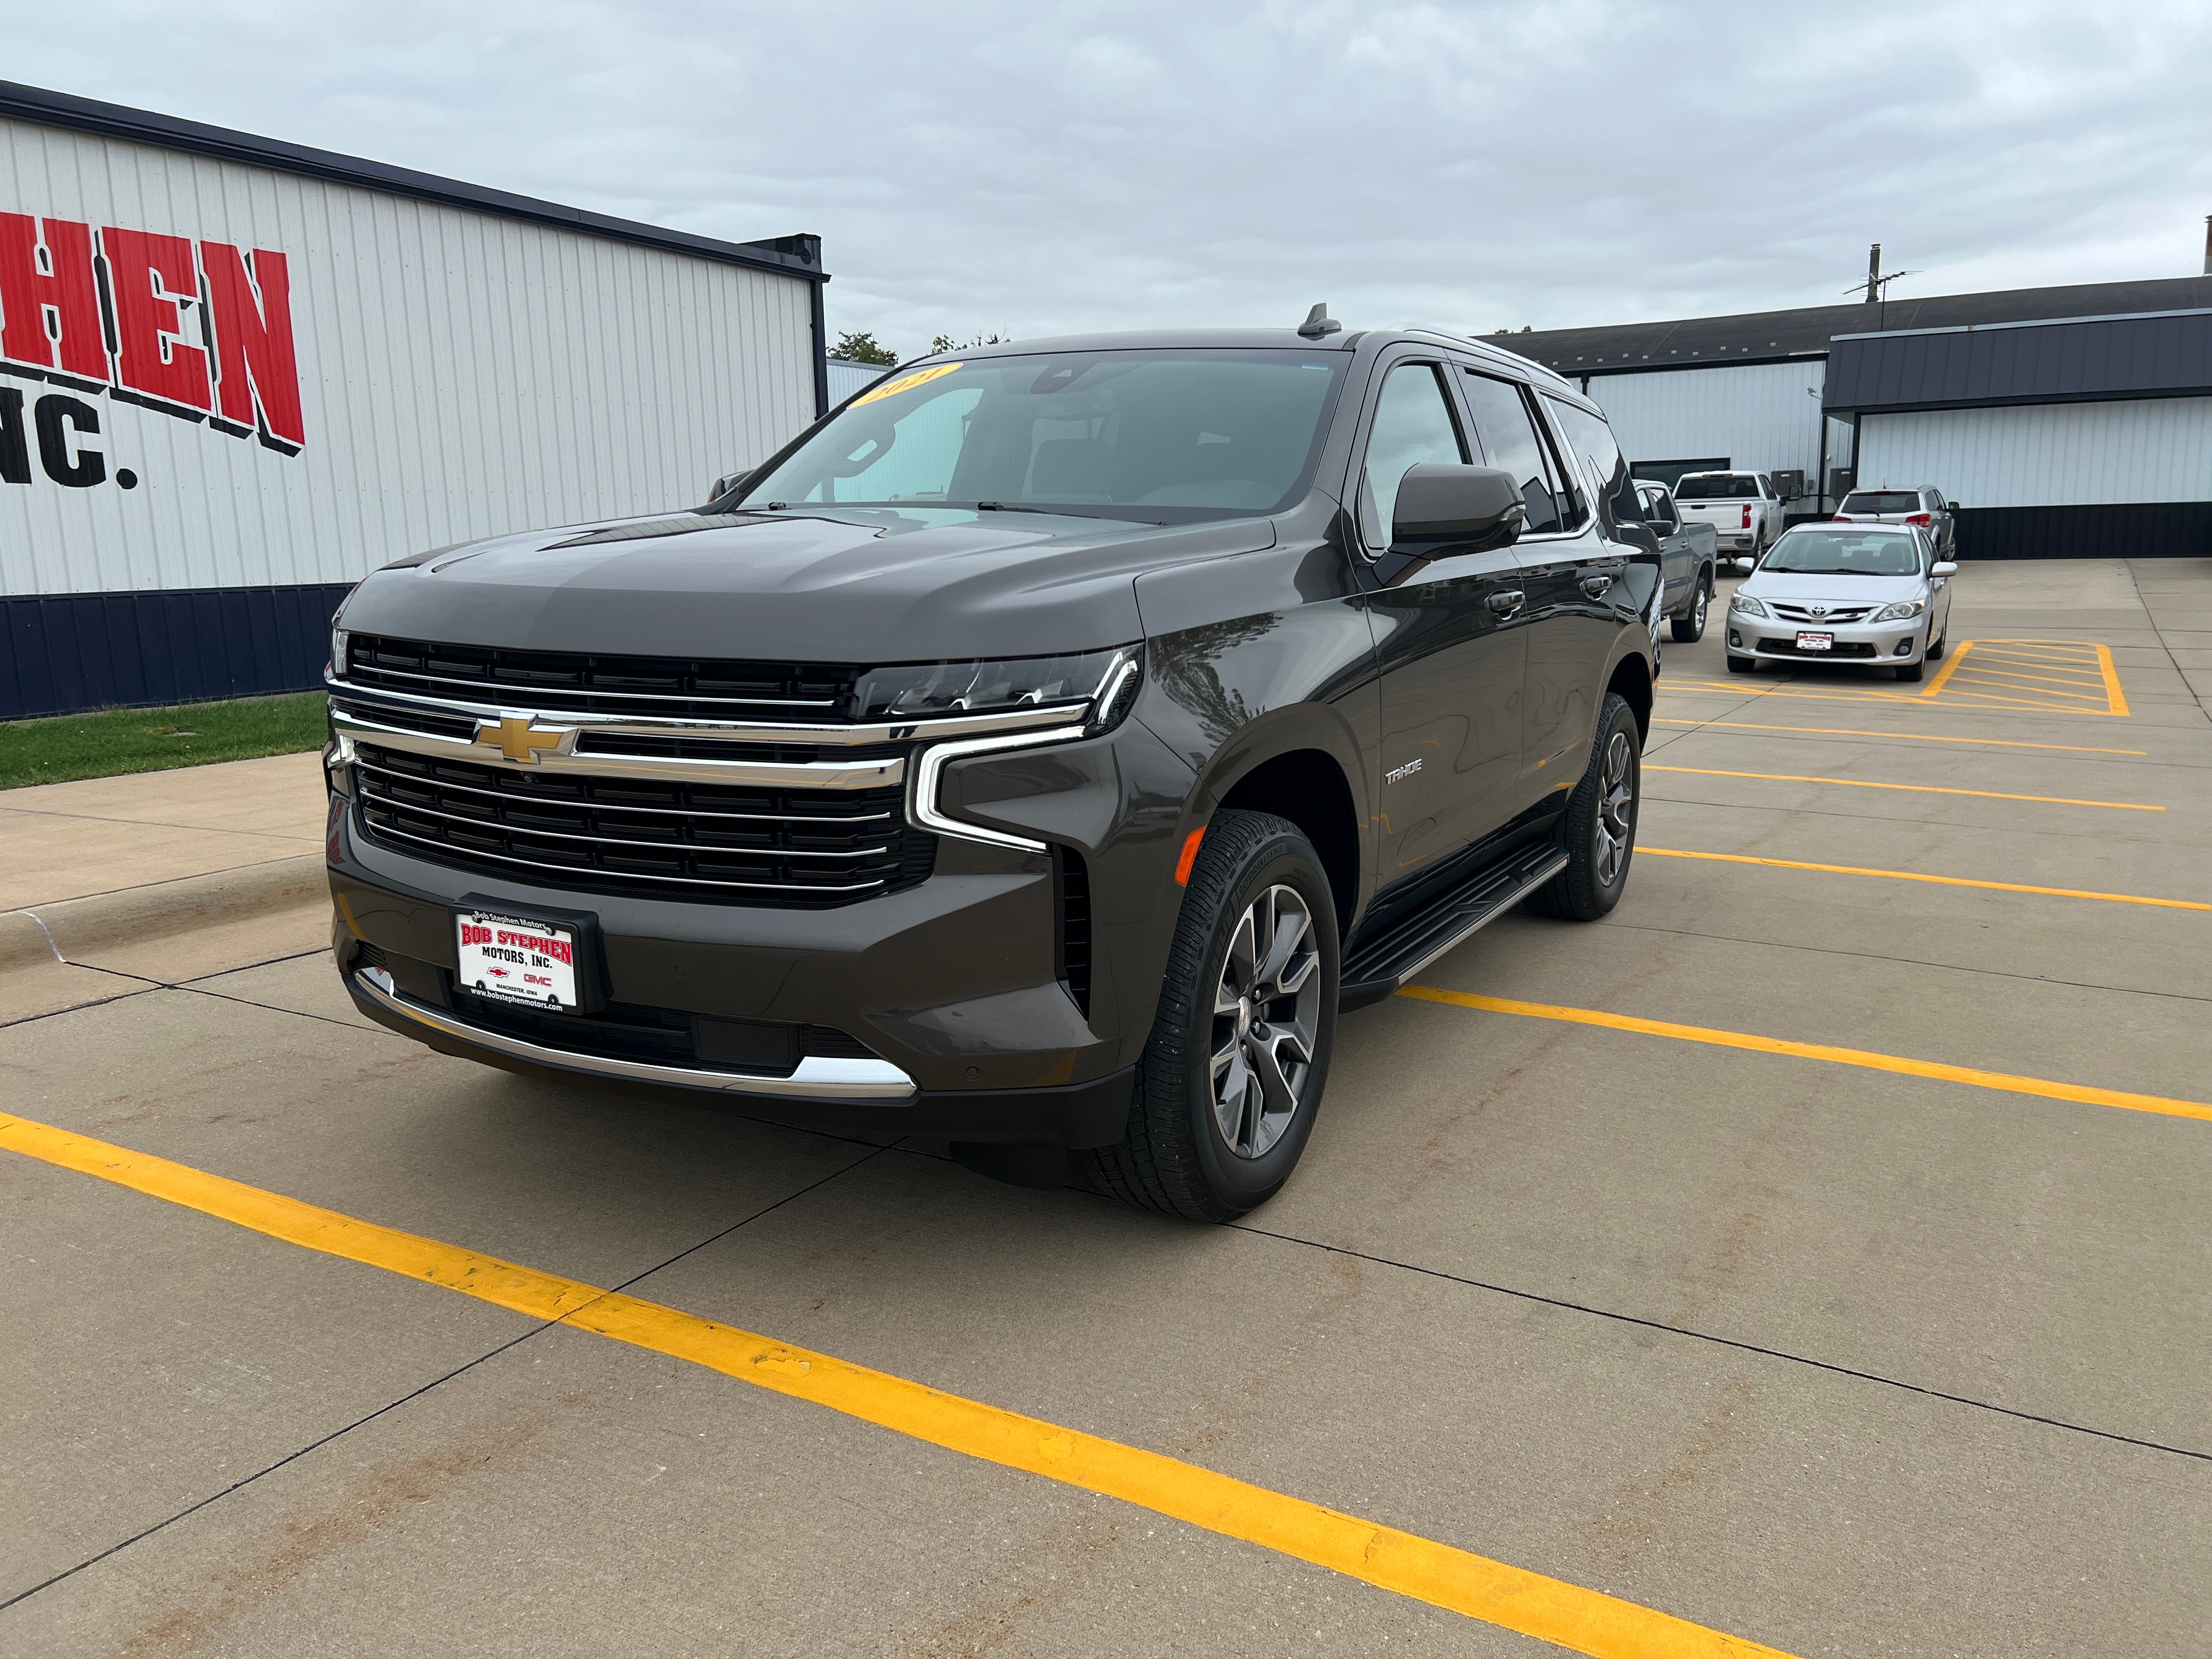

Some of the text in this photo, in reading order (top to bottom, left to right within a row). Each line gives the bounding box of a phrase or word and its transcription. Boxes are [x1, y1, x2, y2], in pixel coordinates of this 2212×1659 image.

[0, 211, 306, 453] HEN
[864, 367, 944, 404] 2021
[1385, 758, 1422, 785] TAHOE
[1239, 859, 1264, 894] DEFENDER
[475, 911, 546, 930] Bob Stephen Motors
[460, 923, 572, 967] BOB STEPHEN
[482, 946, 553, 969] MOTORS, INC.
[496, 983, 525, 994] MANCHESTER,
[523, 973, 552, 988] GMC
[470, 988, 563, 1012] www.bobstephenmotors.com
